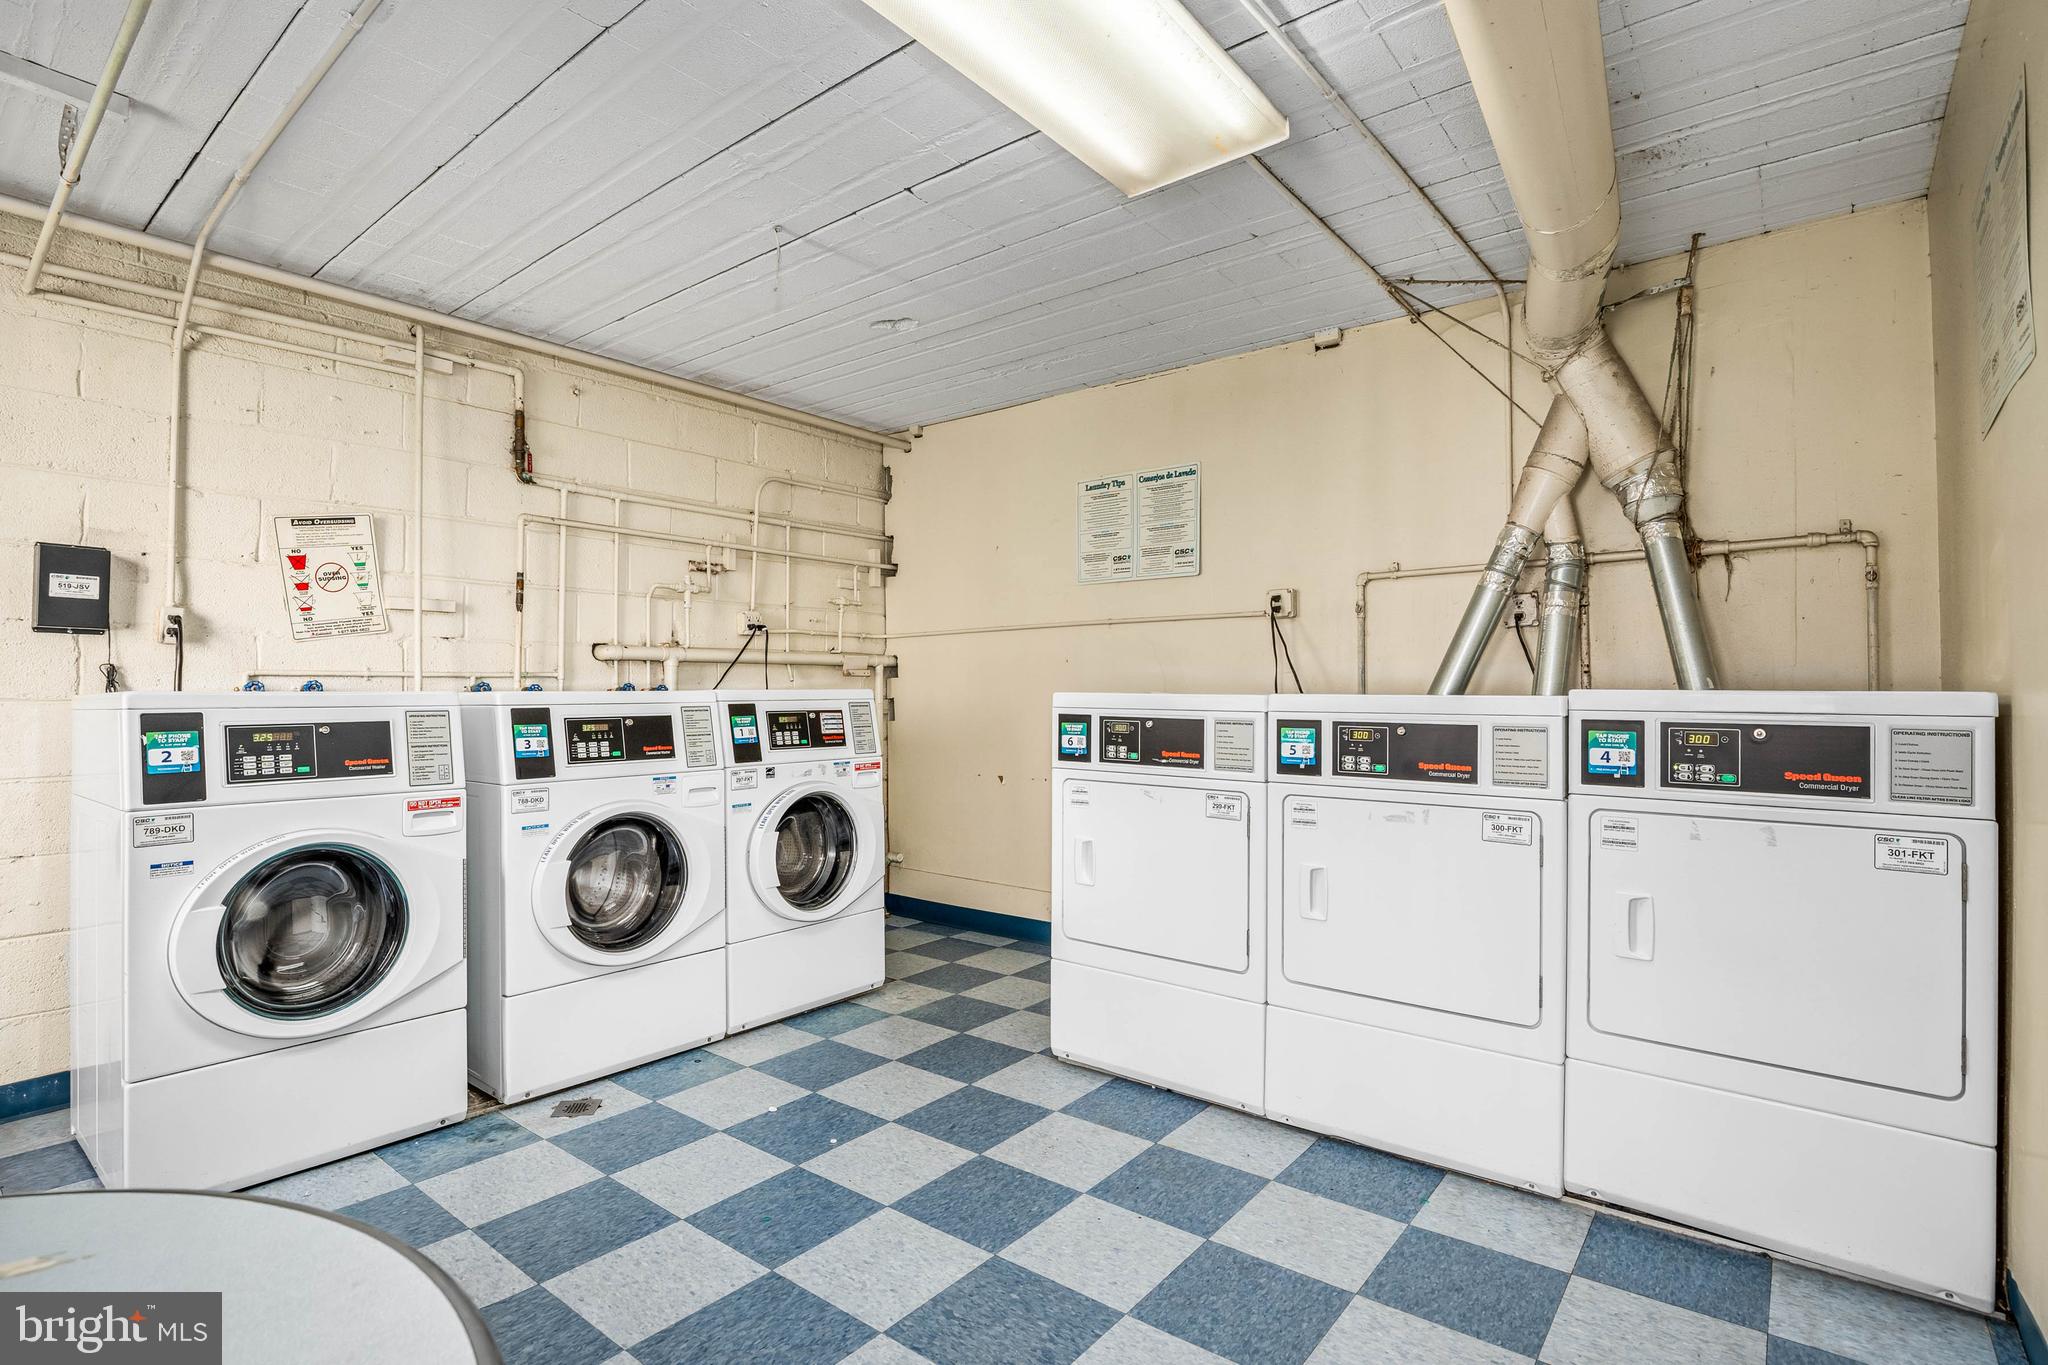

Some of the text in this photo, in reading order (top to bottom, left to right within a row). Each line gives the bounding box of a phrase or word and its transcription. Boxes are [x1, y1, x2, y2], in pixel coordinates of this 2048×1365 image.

[1138, 468, 1196, 484] Consejos de Lavado
[1086, 480, 1126, 492] Laundry Tips
[524, 740, 531, 749] 3
[1068, 737, 1073, 746] 6
[1289, 745, 1296, 755] 5
[161, 751, 172, 762] 2
[1600, 751, 1611, 763] 4
[1418, 761, 1472, 772] Speed Queen
[1784, 771, 1862, 782] Speed Queen
[1799, 782, 1860, 792] Commercial Dryer
[143, 825, 186, 835] 789-DKD
[1491, 824, 1524, 833] 300-FKT
[1888, 849, 1935, 860] 301-FKT
